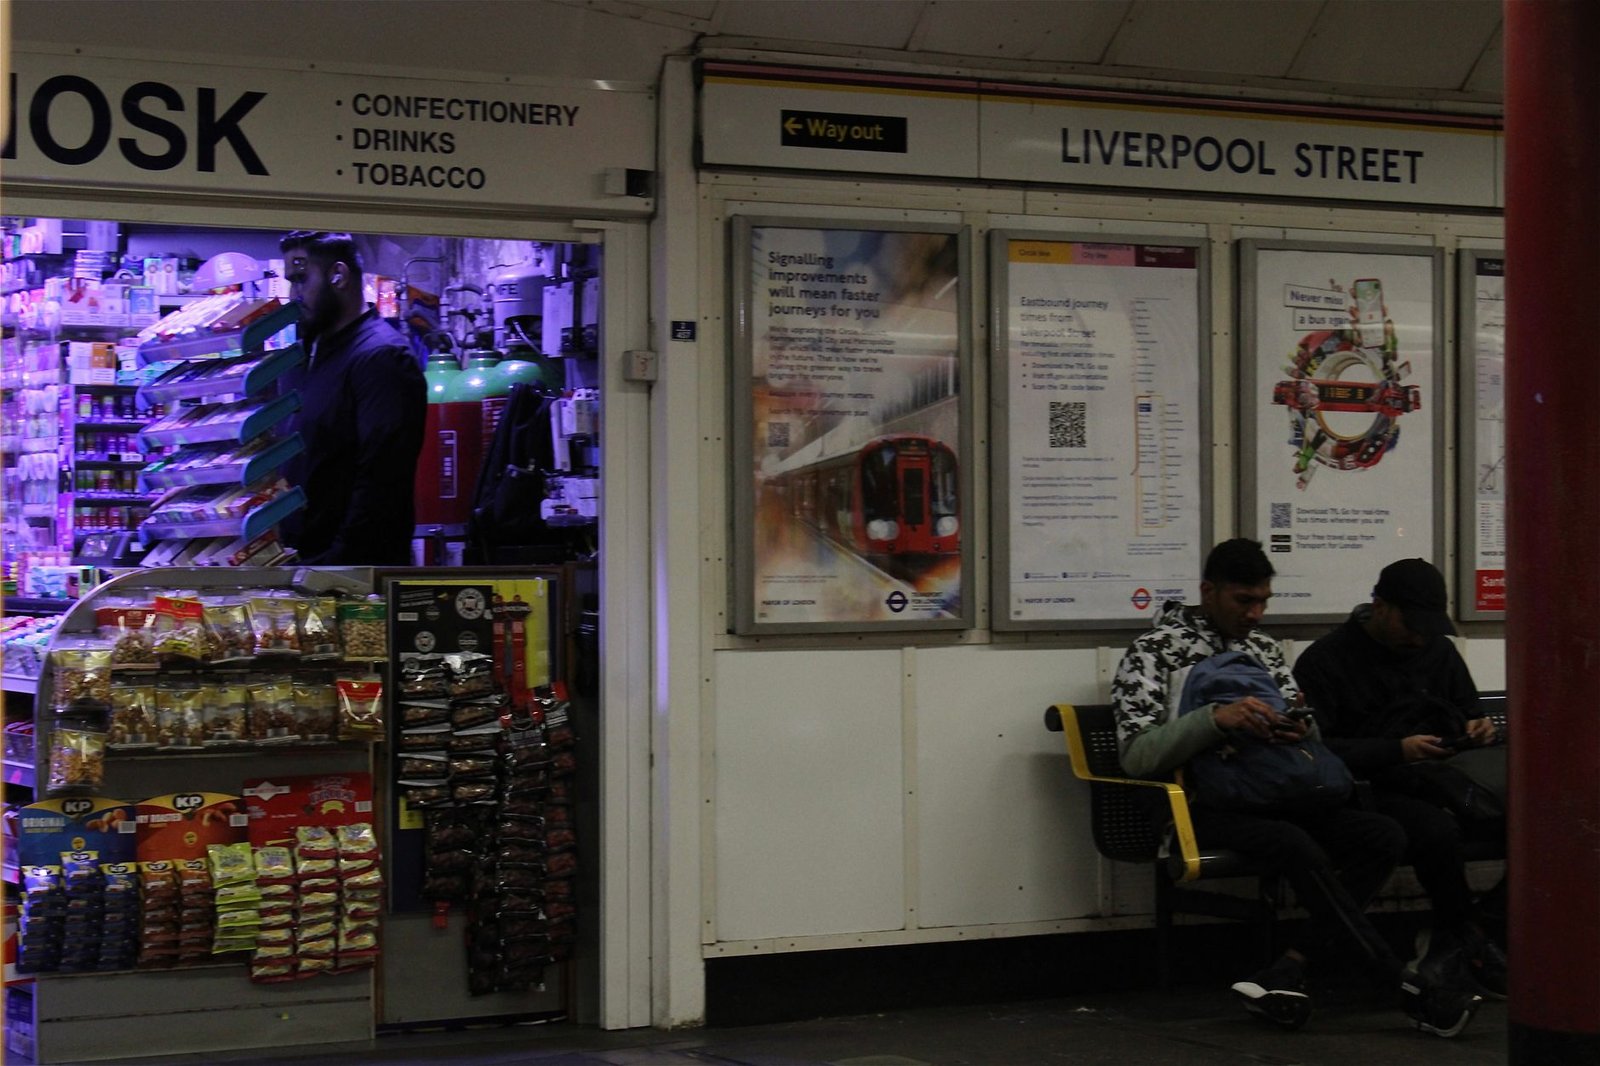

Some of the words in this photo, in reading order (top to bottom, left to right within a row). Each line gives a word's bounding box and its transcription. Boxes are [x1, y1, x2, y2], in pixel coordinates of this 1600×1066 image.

[353, 93, 579, 127] CONFECTIONERY
[807, 118, 848, 142] Way
[850, 124, 884, 140] out
[353, 128, 456, 154] DRINKS
[1061, 128, 1276, 175] LIVERPOOL
[1294, 142, 1424, 184] STREET
[352, 162, 486, 190] TOBACCO
[768, 251, 834, 269] Signalling
[768, 268, 867, 285] improvements
[768, 286, 795, 298] will
[799, 289, 837, 300] mean
[841, 288, 880, 302] faster
[1290, 290, 1322, 303] Never
[768, 302, 826, 318] journeys
[831, 304, 850, 317] for
[855, 308, 880, 320] you
[1021, 296, 1070, 307] Eastbound
[1072, 298, 1109, 311] journey
[1020, 313, 1047, 322] times
[1049, 313, 1073, 322] from
[1299, 316, 1306, 324] a
[1308, 313, 1326, 325] bus
[65, 801, 92, 812] KP
[175, 796, 203, 808] KP
